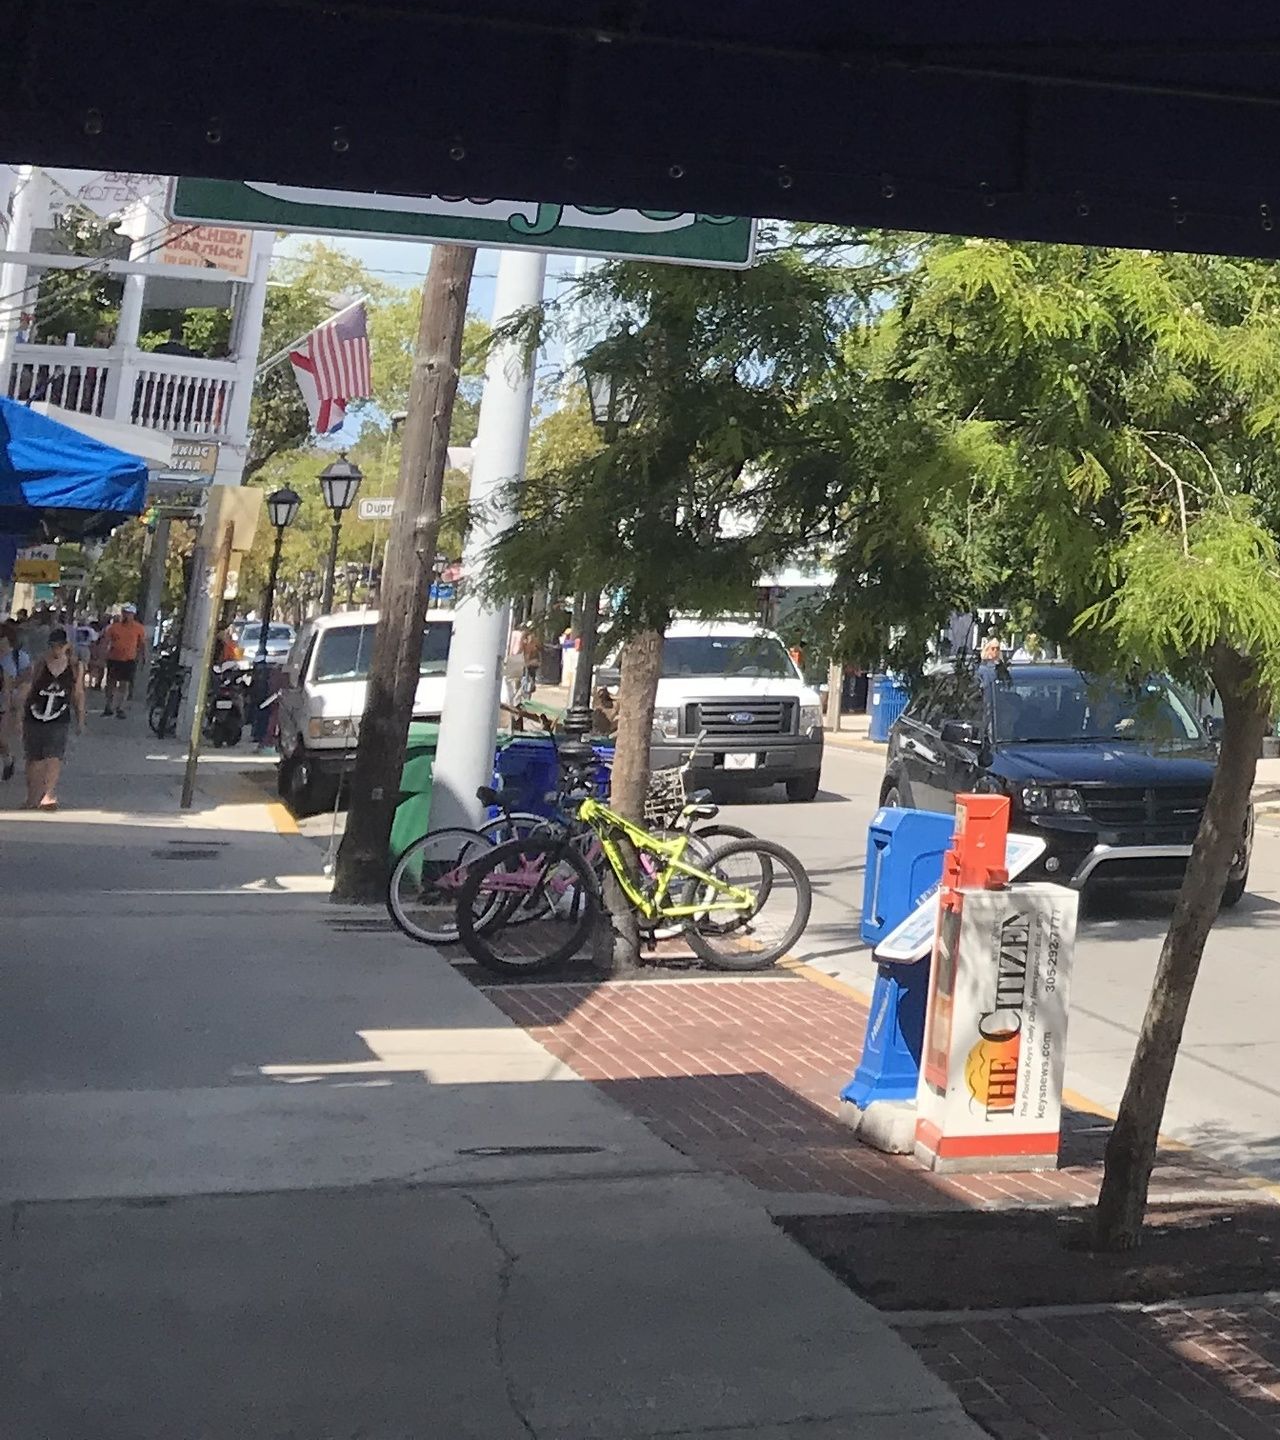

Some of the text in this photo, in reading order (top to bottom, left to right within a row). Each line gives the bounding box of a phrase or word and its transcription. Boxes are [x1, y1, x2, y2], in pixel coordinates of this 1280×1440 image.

[366, 502, 392, 516] Dupr
[977, 910, 1031, 1122] THE CITIZEN
[1034, 1031, 1052, 1120] keysnews.com
